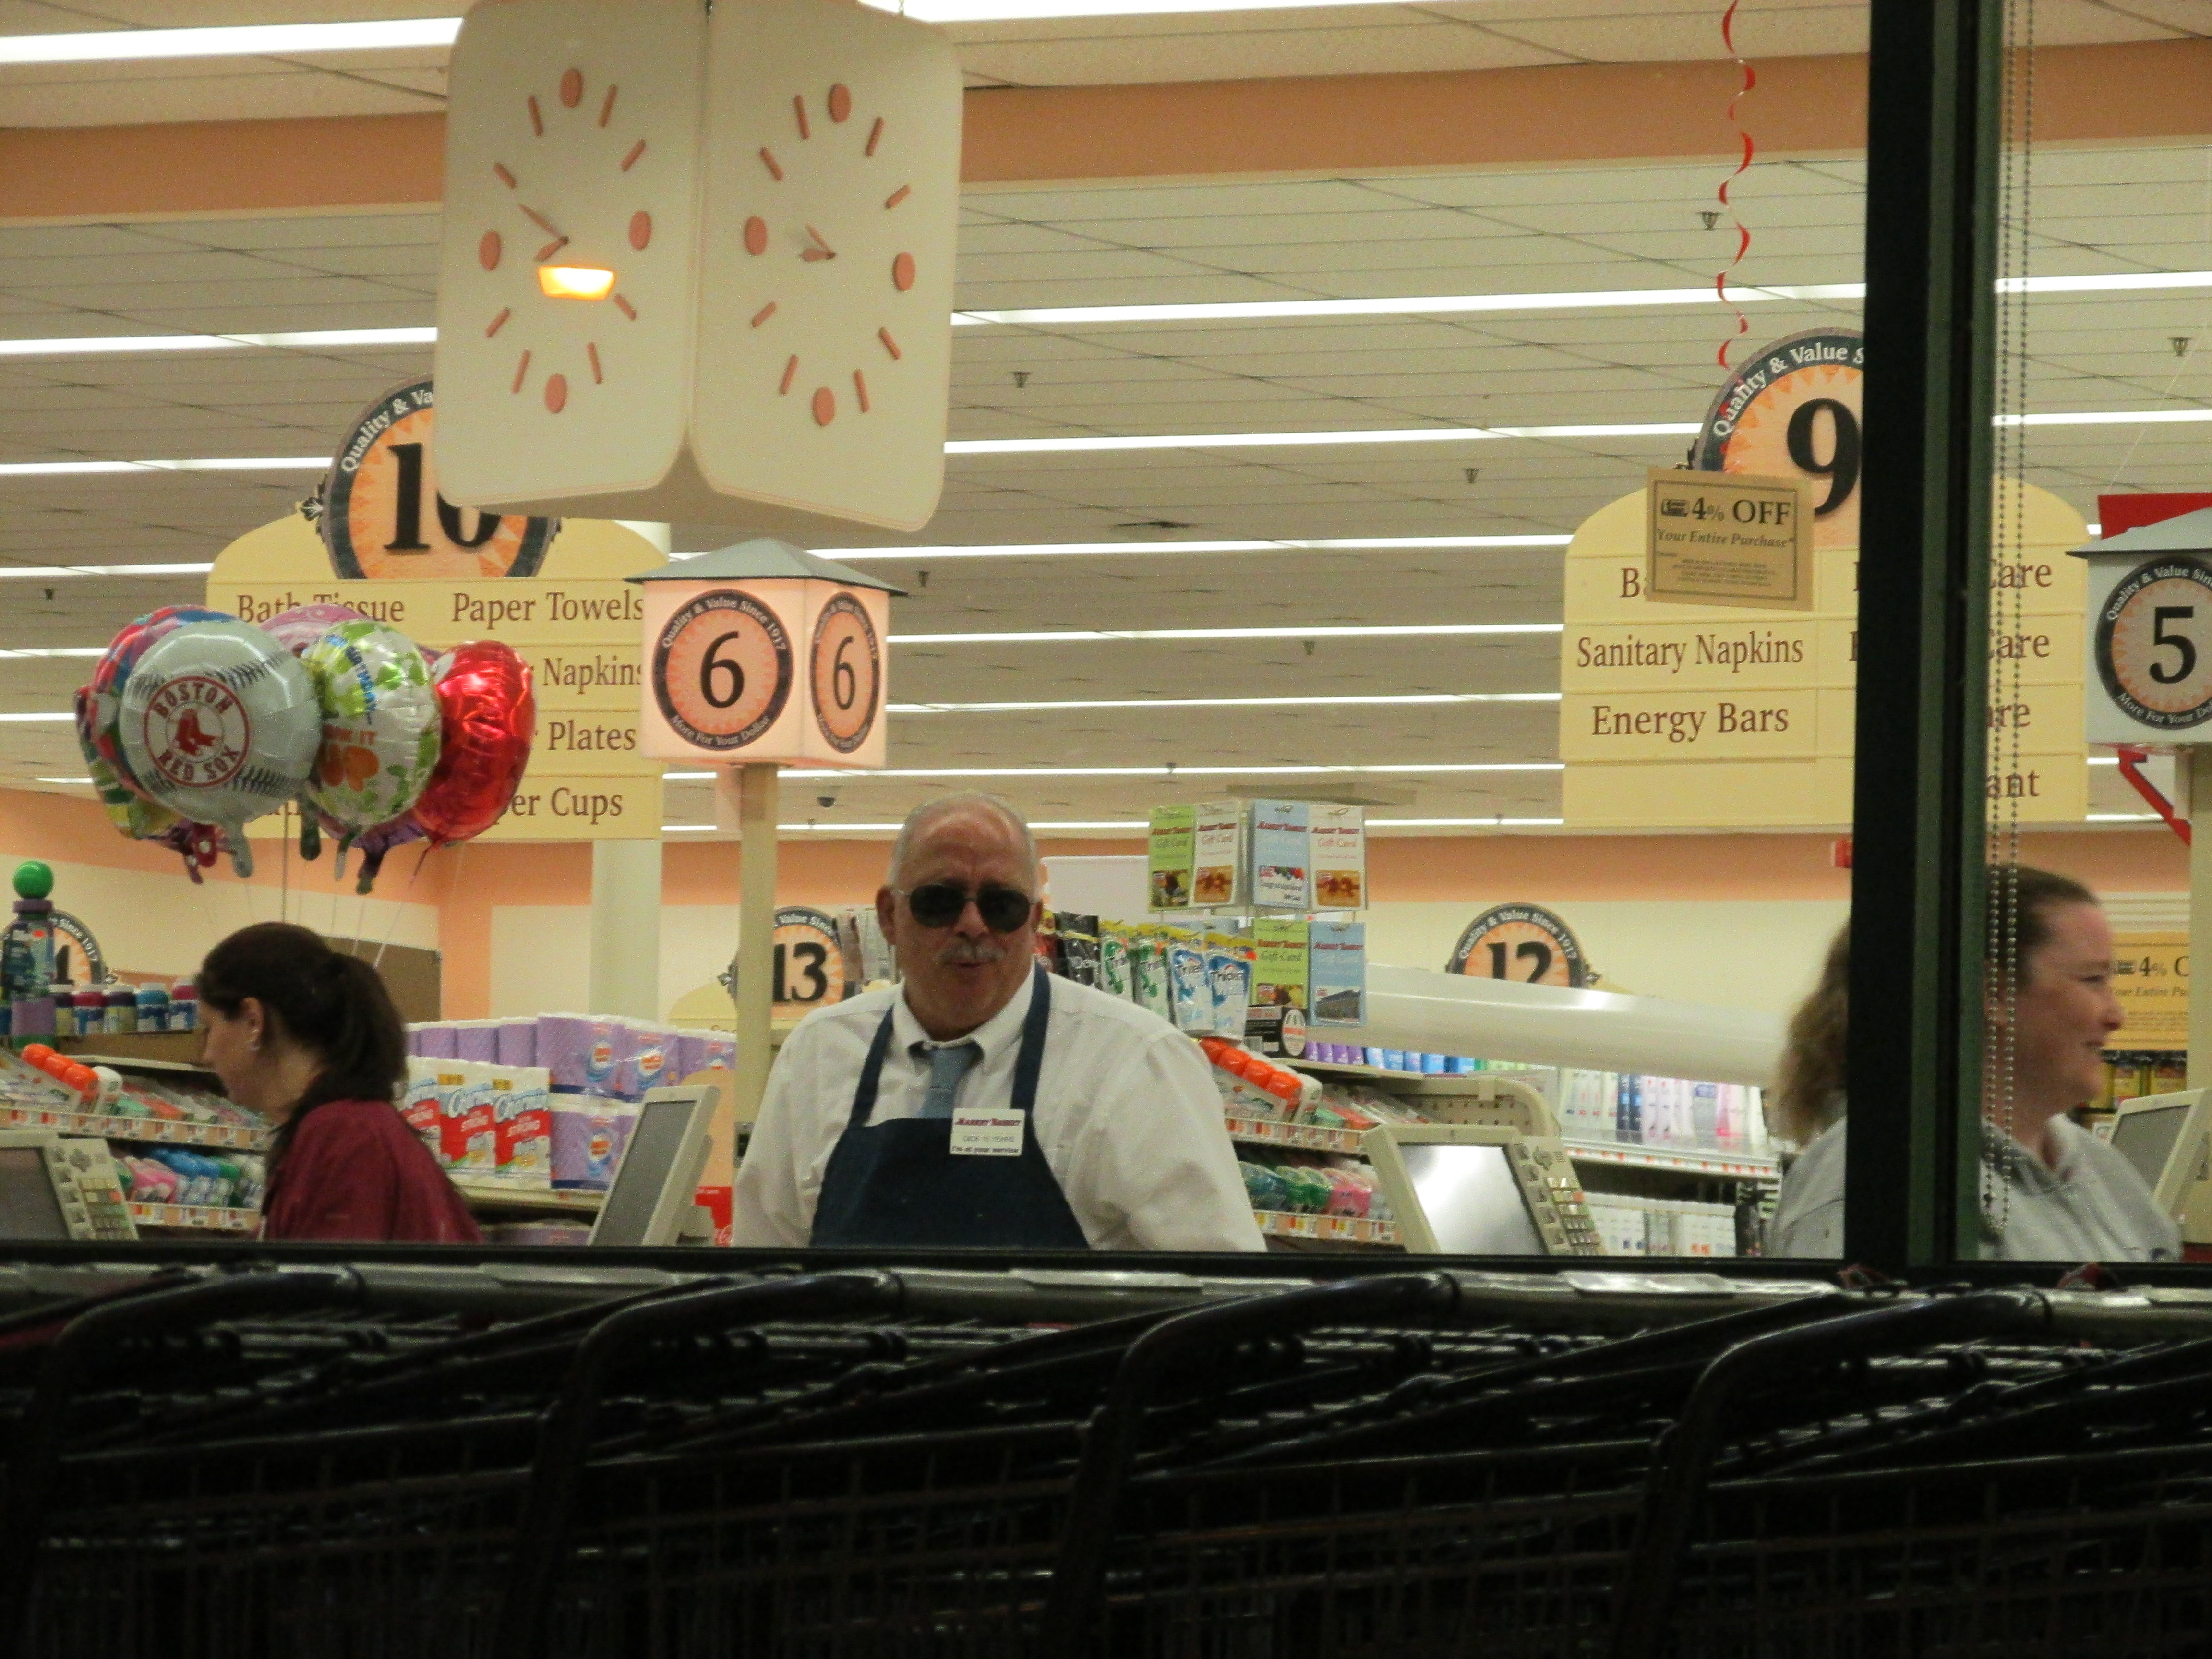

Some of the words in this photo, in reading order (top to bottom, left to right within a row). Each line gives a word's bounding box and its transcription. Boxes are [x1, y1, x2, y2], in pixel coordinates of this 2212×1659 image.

[1713, 370, 1767, 438] Quality
[1769, 357, 1789, 374] &
[1789, 343, 1848, 364] Value
[341, 410, 391, 472] Quality
[393, 398, 409, 414] &
[1787, 397, 1862, 517] 9
[1692, 497, 1725, 522] 4%
[1732, 499, 1792, 525] OFF
[1656, 528, 1687, 542] Your
[1689, 530, 1727, 545] Entire
[452, 593, 536, 630] Paper
[546, 589, 644, 621] Towels
[2106, 580, 2140, 621] Quality
[2154, 566, 2190, 577] Value
[662, 610, 692, 648] Quality
[705, 597, 737, 608] Value
[739, 600, 769, 623] Since
[767, 623, 786, 650] 1917
[2149, 606, 2196, 684] 5
[700, 630, 744, 709] 6
[833, 636, 855, 710] 6
[1577, 634, 1687, 674] Sanitary
[1695, 630, 1803, 673] Napkins
[153, 681, 234, 718] BOSTON
[2117, 692, 2145, 718] More
[548, 720, 636, 750] Plates
[1592, 705, 1707, 743] Energy
[1718, 702, 1789, 733] Bars
[158, 748, 195, 780] RED
[203, 745, 240, 780] SOX
[551, 787, 623, 825] Cups
[773, 942, 828, 1002] 13
[1486, 941, 1552, 983] 12
